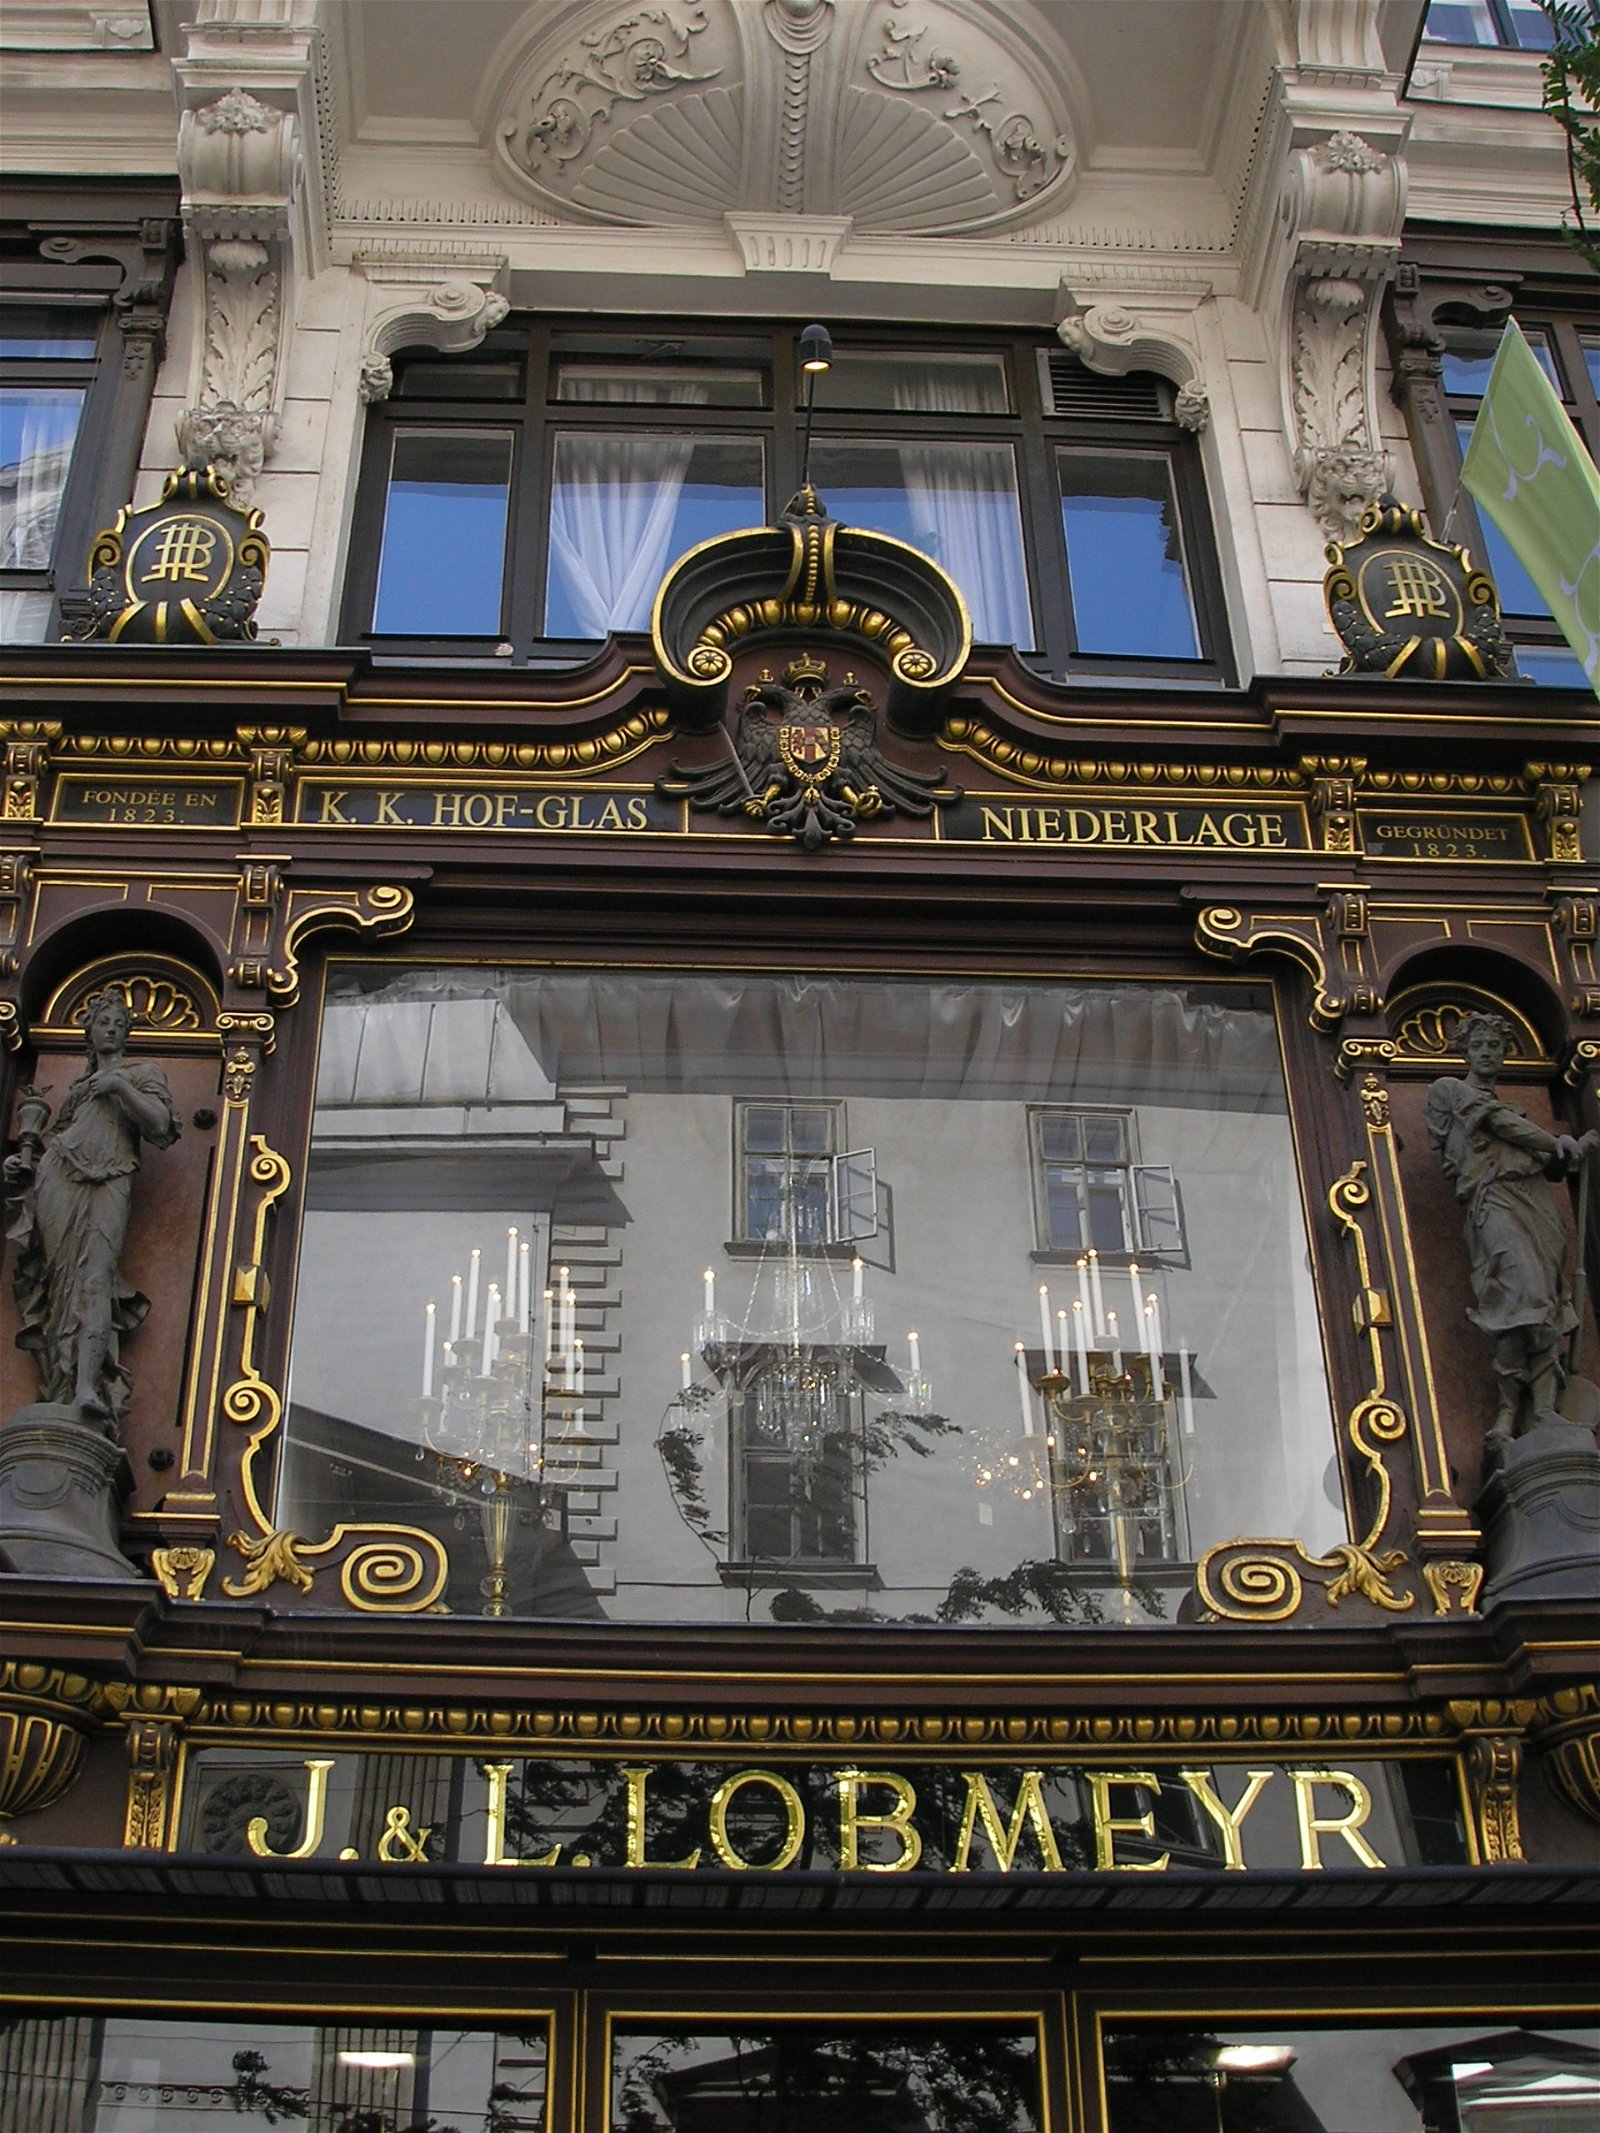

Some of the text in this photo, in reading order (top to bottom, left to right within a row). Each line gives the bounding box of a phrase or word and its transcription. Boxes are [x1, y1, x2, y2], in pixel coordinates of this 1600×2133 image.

[185, 793, 217, 807] EN
[318, 791, 648, 830] K. K. HOF-GLAS
[980, 807, 1288, 848] NIEDERLAGE
[1376, 825, 1510, 841] GEGRÜNDET
[247, 1760, 1387, 1873] J. & L. LOBMEYR
